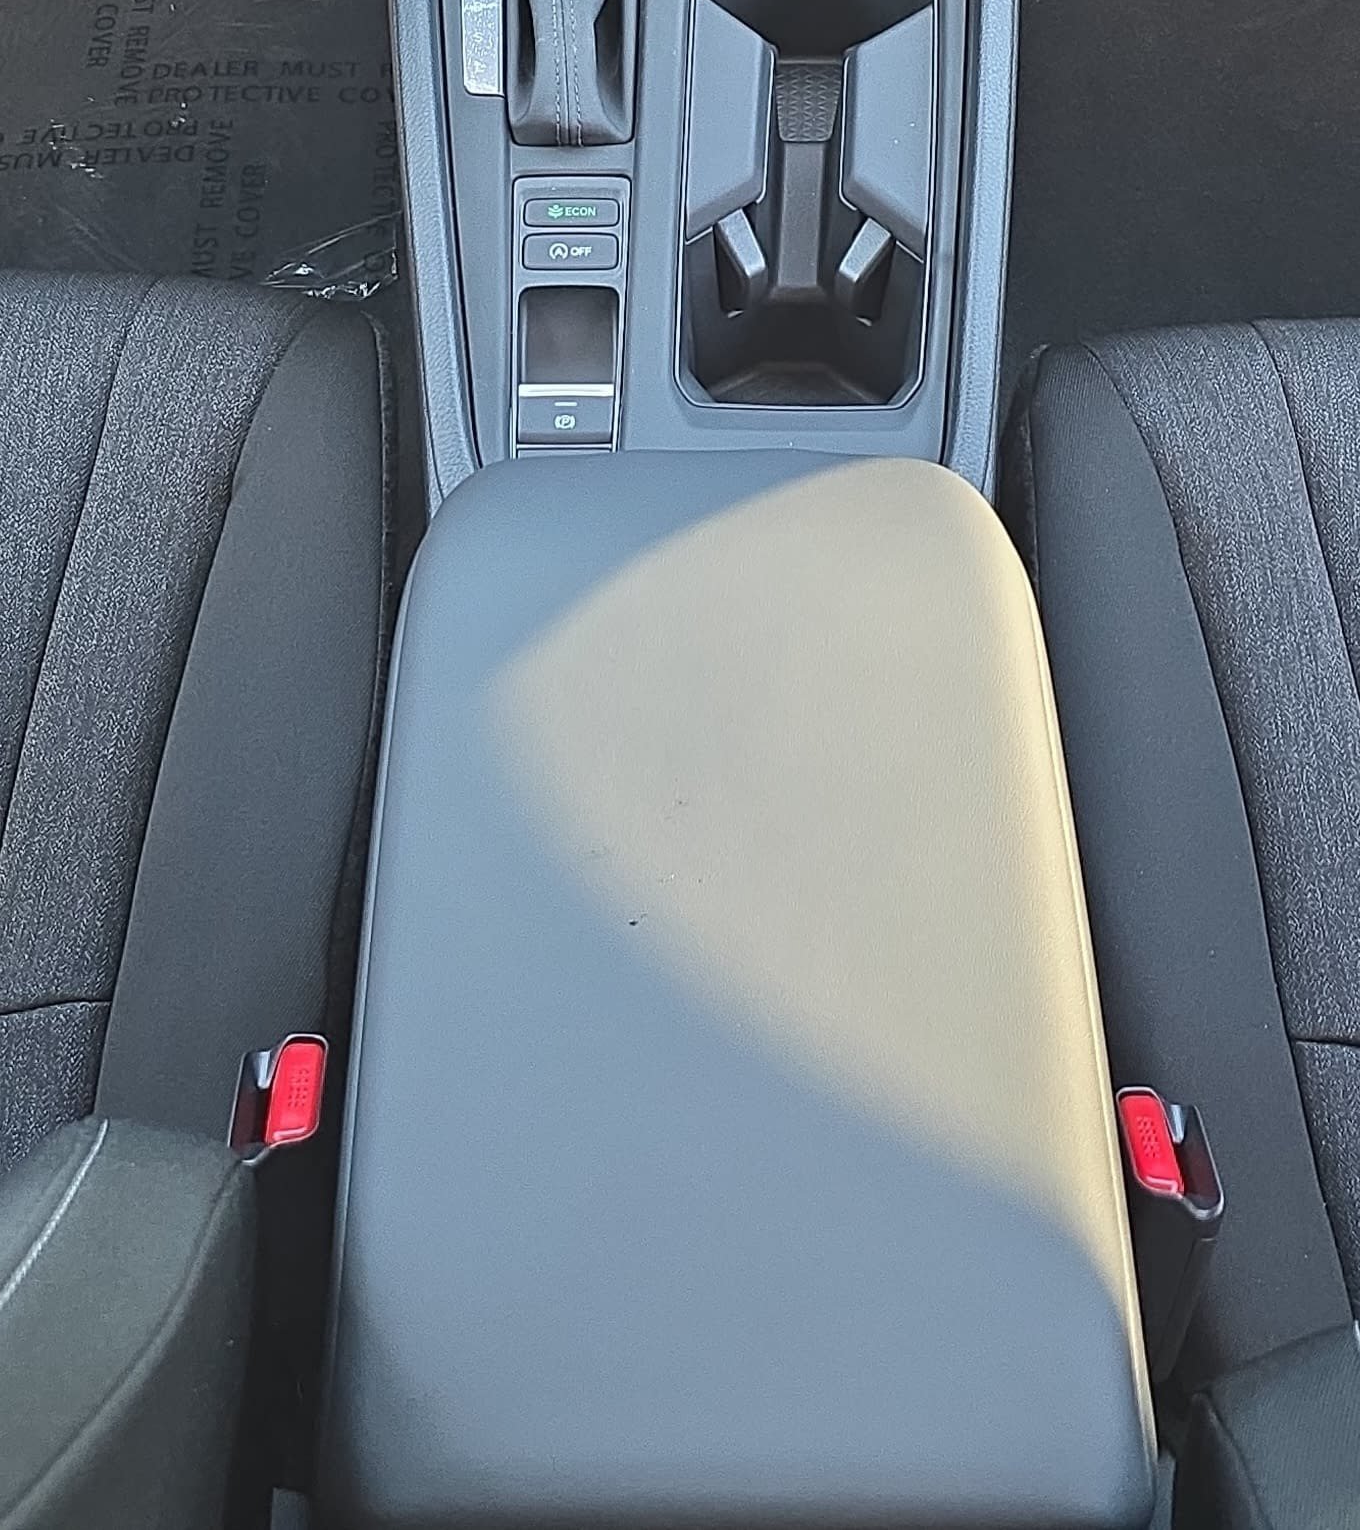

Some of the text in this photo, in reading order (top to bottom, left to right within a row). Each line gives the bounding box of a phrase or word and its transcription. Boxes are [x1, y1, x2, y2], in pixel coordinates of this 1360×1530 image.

[87, 3, 119, 69] COVER
[114, 24, 151, 108] REMOVE
[151, 60, 260, 80] DEALER
[281, 60, 362, 79] MUST
[148, 85, 322, 104] PROTECTIVE
[199, 119, 234, 209] REMOVE
[237, 163, 267, 240] COVER
[565, 207, 596, 217] ECON
[570, 247, 593, 257] OFF
